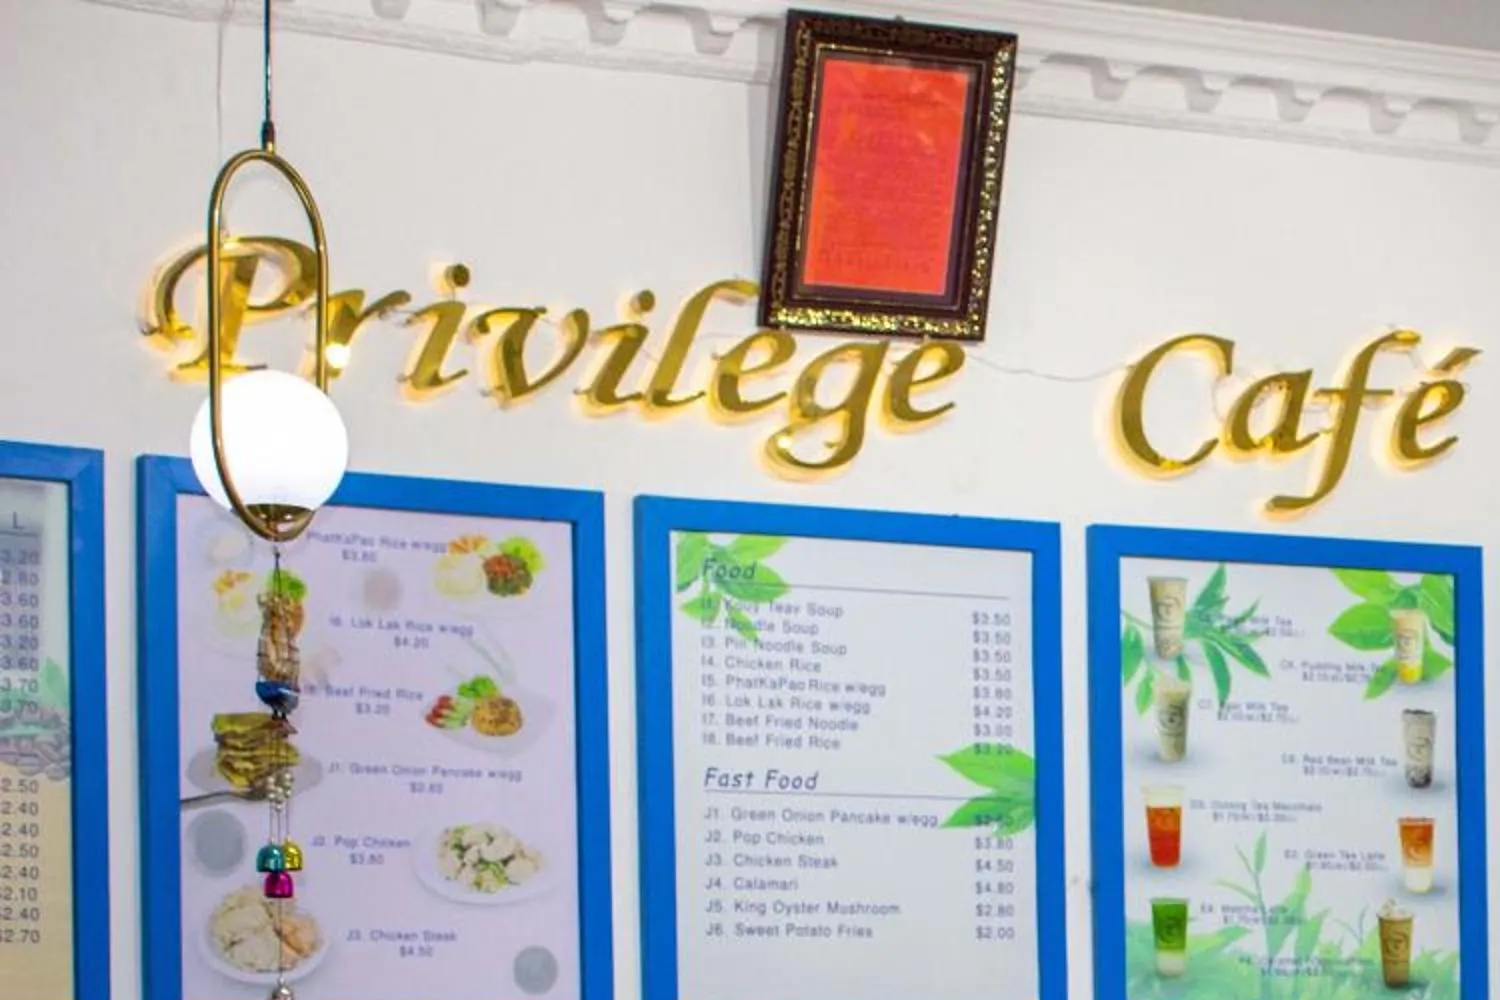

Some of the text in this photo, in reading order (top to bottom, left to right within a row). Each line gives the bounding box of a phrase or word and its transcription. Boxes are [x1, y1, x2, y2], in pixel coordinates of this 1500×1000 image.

[150, 236, 1482, 511] Privilege Café
[12, 511, 25, 530] L
[703, 558, 757, 580] Food
[807, 602, 844, 619] Soup
[783, 620, 819, 636] Soup
[812, 641, 847, 657] Soup
[725, 656, 783, 671] Chicken
[790, 658, 822, 673] Rice
[808, 677, 840, 692] Rice
[791, 696, 822, 711] Rice
[726, 713, 759, 727] Beef
[766, 714, 802, 729] Fried
[809, 716, 859, 732] Noodle
[726, 732, 759, 746] Beef
[766, 734, 802, 749] Fried
[809, 736, 840, 750] Rice
[704, 767, 819, 791] Fast Food
[731, 807, 776, 822] Green
[782, 808, 825, 823] Onion
[830, 809, 891, 825] Pancake
[733, 830, 761, 845] Pop
[766, 832, 824, 846] Chicken
[733, 854, 793, 868] Chicken
[798, 855, 839, 869] Steak
[733, 877, 798, 892] Calamari
[734, 900, 767, 917] King
[773, 900, 820, 917] Oyster
[827, 901, 901, 917] Mushroom
[370, 930, 419, 943] Chicken
[734, 922, 780, 938] Sweet
[786, 923, 832, 939] Potato
[838, 924, 873, 939] Fries
